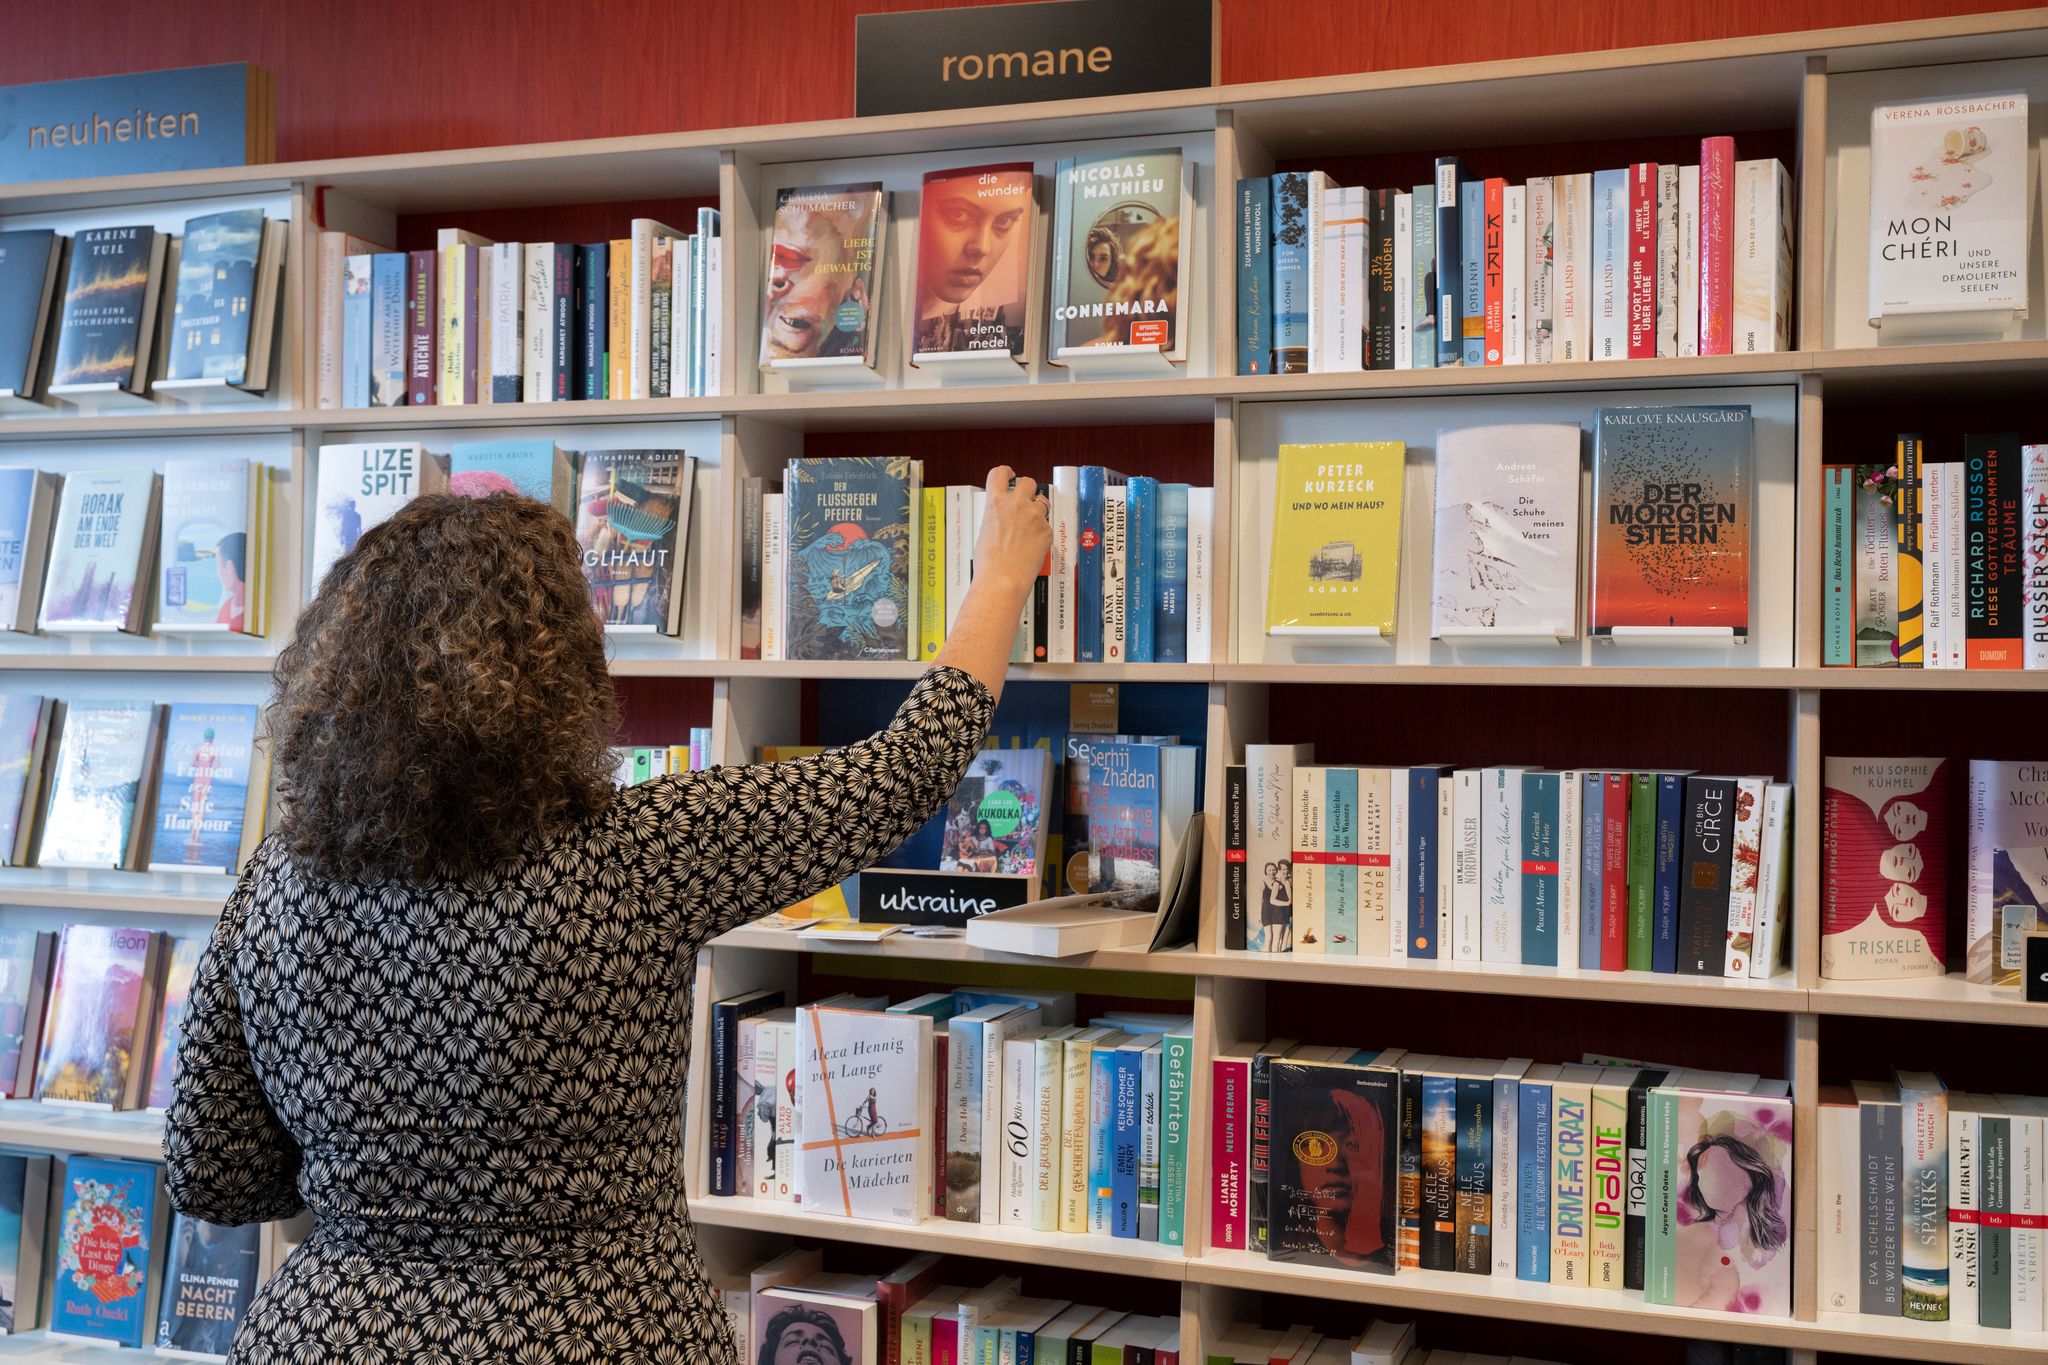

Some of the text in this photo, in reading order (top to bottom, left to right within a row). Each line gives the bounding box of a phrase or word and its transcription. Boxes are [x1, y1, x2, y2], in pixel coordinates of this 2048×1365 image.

[942, 46, 1112, 81] romane
[1885, 101, 2016, 120] VERENA ROSSBACHER
[29, 109, 199, 150] neuheiten
[978, 174, 997, 185] die
[1068, 163, 1145, 183] NICOLAS
[780, 192, 828, 202] CLAUDIA
[978, 185, 1024, 197] wunder
[1083, 179, 1164, 199] MATHIEU
[779, 201, 855, 215] SCHUMACHER
[85, 228, 136, 242] KARINE
[1888, 215, 1951, 237] MON
[93, 244, 124, 255] TUIL
[844, 238, 874, 248] LIEBE
[1487, 214, 1500, 287] KURT
[1882, 237, 1957, 261] CHÉRI
[1969, 249, 1991, 257] UND
[856, 250, 873, 259] IST
[1384, 237, 1393, 292] STUNDEN
[1960, 260, 2000, 269] UNSERE
[815, 263, 872, 274] GEWALTIG
[1634, 260, 1642, 289] MEHR
[1943, 270, 2017, 282] DEMOLIERTEN
[1470, 262, 1478, 313] KINTSUGI
[1565, 265, 1573, 318] HERA LIND
[1961, 283, 1998, 292] SEELEN
[417, 273, 427, 328] AMERICANAH
[500, 280, 511, 323] PATRIA
[1055, 299, 1168, 320] CONNEMARA
[1643, 275, 1651, 331] ÜBER LIEBE
[970, 323, 1004, 335] elena
[1633, 323, 1641, 347] KEIN
[968, 336, 1007, 348] medel
[417, 334, 429, 378] ADICHIE
[1605, 410, 1744, 425] KARL OVE KNAUSGÅRD
[362, 449, 413, 472] LIZE
[586, 453, 680, 463] KATHARINA ADLER
[1496, 463, 1536, 471] Andreas
[1318, 464, 1363, 477] PETER
[1508, 474, 1545, 483] Schäfer
[361, 473, 413, 496] SPIT
[835, 482, 847, 491] DER
[1305, 480, 1374, 493] KURZECK
[1644, 483, 1701, 503] DER
[81, 493, 124, 514] HORAK
[818, 494, 877, 506] FLUSSREGEN
[1356, 501, 1384, 509] HAUS?
[77, 516, 119, 531] AM ENDE
[825, 509, 862, 521] PFEIFER
[1610, 504, 1735, 524] MORGEN
[75, 533, 117, 548] DER WELT
[1522, 531, 1550, 539] Vaters
[1626, 525, 1718, 544] STERN
[1971, 458, 1984, 618] RICHARD RUSSO
[1988, 449, 1998, 626] DIESE GOTTVERDAMMTEN
[2002, 500, 2016, 575] TRÄUME
[583, 549, 669, 567] GLHAUT
[1116, 577, 1124, 641] GRIGORCEA
[1980, 650, 2007, 661] DUMONT
[176, 762, 233, 778] Frauen
[1090, 748, 1129, 773] Serhij
[1853, 766, 1928, 775] MIKU SOPHIE
[1102, 767, 1155, 789] Zhadan
[1868, 778, 1913, 788] KÜHMEL
[180, 798, 214, 812] Safe
[977, 808, 1020, 820] KUKOLKA
[164, 815, 232, 831] Harbour
[1702, 789, 1722, 853] CIRCE
[1464, 818, 1477, 885] NORDWASSER
[880, 887, 997, 916] ukraine
[1375, 871, 1384, 921] LUNDE
[1536, 908, 1544, 932] Pascal
[1849, 940, 1921, 955] TRISKELE
[808, 1038, 904, 1063] Alexa Hennig
[812, 1064, 882, 1082] von Lange
[1118, 1067, 1126, 1108] SOMMER
[1168, 1045, 1184, 1144] Gefährten
[1226, 1078, 1234, 1153] NEUN FREMDE
[1072, 1087, 1085, 1192] GESCHICHTENBÄCKER
[824, 1153, 912, 1173] Die karierten
[1126, 1144, 1134, 1176] HENRY
[1558, 1097, 1584, 1238] DRIVE ME CRAZY
[1595, 1126, 1621, 1229] UP TO DATE
[1960, 1136, 1970, 1205] HERKUNFT
[849, 1174, 909, 1189] Mädchen
[1221, 1173, 1229, 1204] LIANE
[1230, 1161, 1238, 1217] MORIARTY
[1404, 1155, 1415, 1214] NEUHAUS
[1426, 1172, 1437, 1203] NELE
[1438, 1159, 1449, 1219] NEUHAUS
[1462, 1175, 1472, 1207] NELE
[1474, 1162, 1484, 1221] NEUHAUS
[1630, 1156, 1646, 1209] 1984
[1922, 1169, 1937, 1246] SPARKS
[1869, 1155, 1879, 1285] EVA SICHELSCHMIDT
[83, 1237, 120, 1250] Die leise
[1561, 1240, 1578, 1248] Beth
[1955, 1228, 1963, 1258] SAŠA
[81, 1247, 120, 1261] Last der
[88, 1260, 114, 1273] Dinge
[2018, 1234, 2026, 1302] ELIZABETH
[180, 1274, 239, 1288] ELINA PENNER
[181, 1286, 236, 1304] NACHT
[176, 1302, 235, 1320] BEEREN
